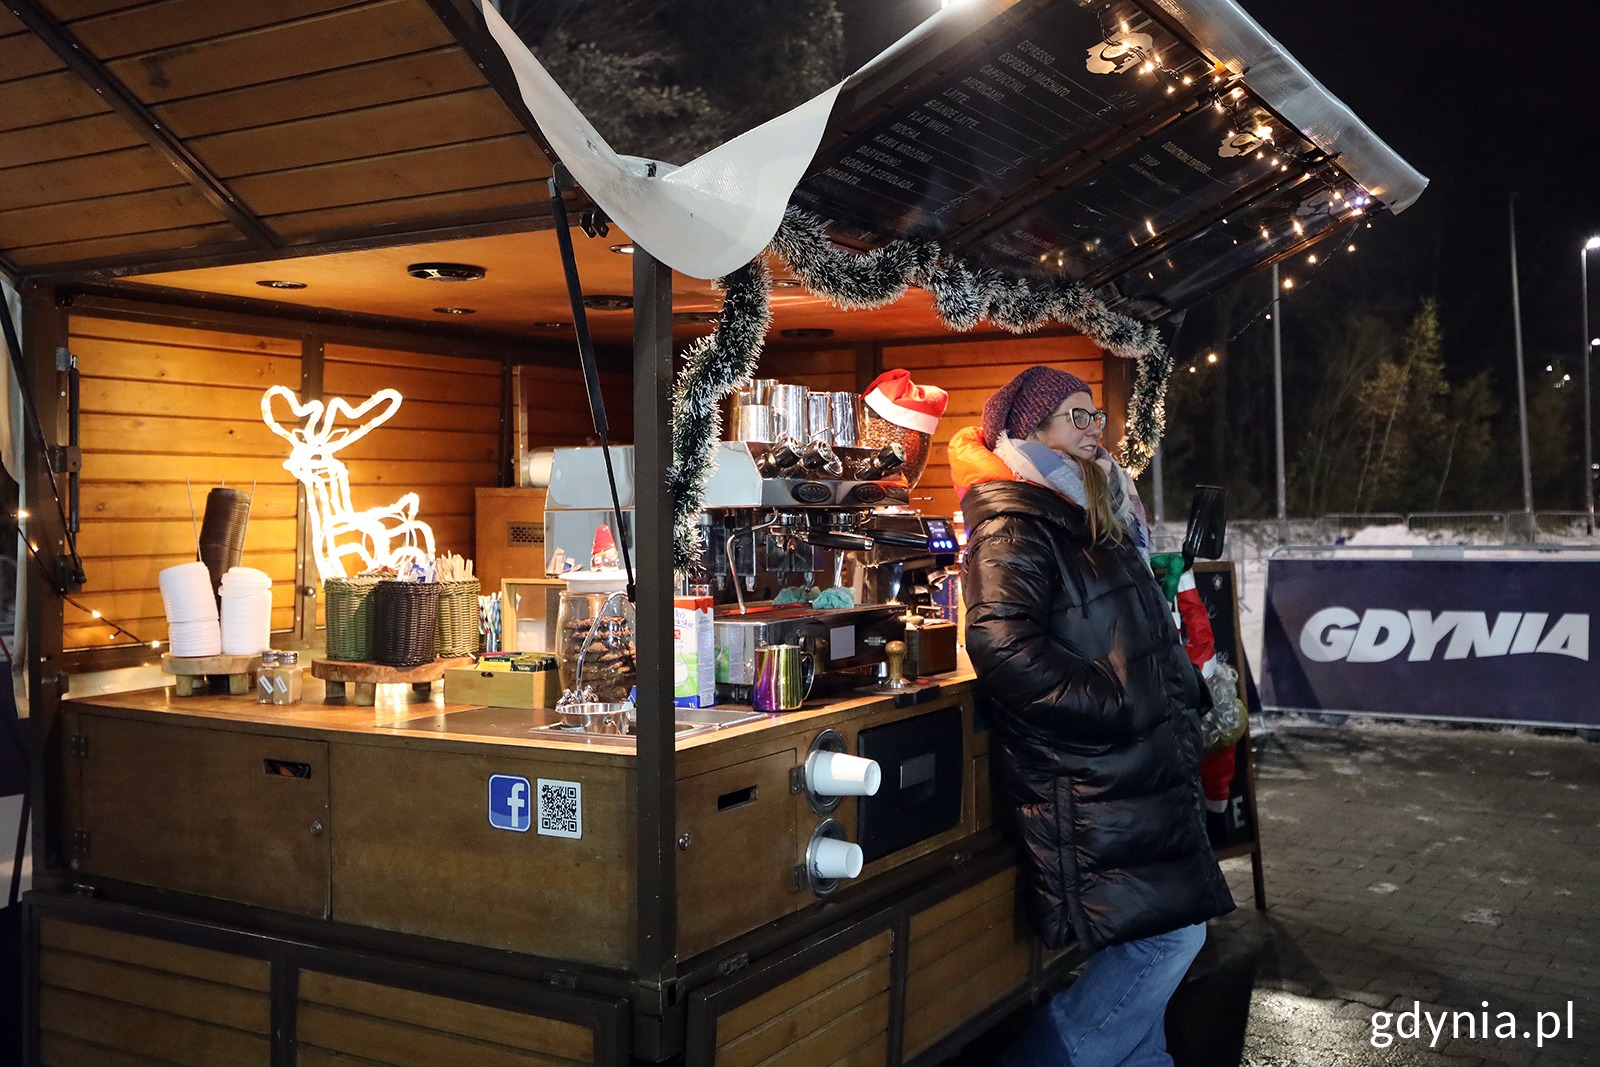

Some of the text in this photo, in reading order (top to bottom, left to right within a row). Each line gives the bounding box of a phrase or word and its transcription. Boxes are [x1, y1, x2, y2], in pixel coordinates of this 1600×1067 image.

[1016, 39, 1056, 65] ESPRESSO
[979, 63, 1027, 93] CAPPUCCINO
[998, 51, 1037, 78] ESPRESSO
[1032, 72, 1071, 98] MACCHIATO
[942, 87, 971, 104] LATTE
[960, 76, 1006, 103] AMERICANO
[907, 110, 931, 125] FLAT
[926, 118, 954, 136] WHITE
[923, 99, 980, 129] GRANDE LATTE
[872, 133, 900, 148] KAWA
[889, 121, 921, 140] MOCHA
[855, 144, 902, 167] BABYCCINO
[822, 166, 861, 186] HERBATA
[870, 168, 915, 190] CZEKOLADA
[1300, 606, 1590, 662] GDYNIA
